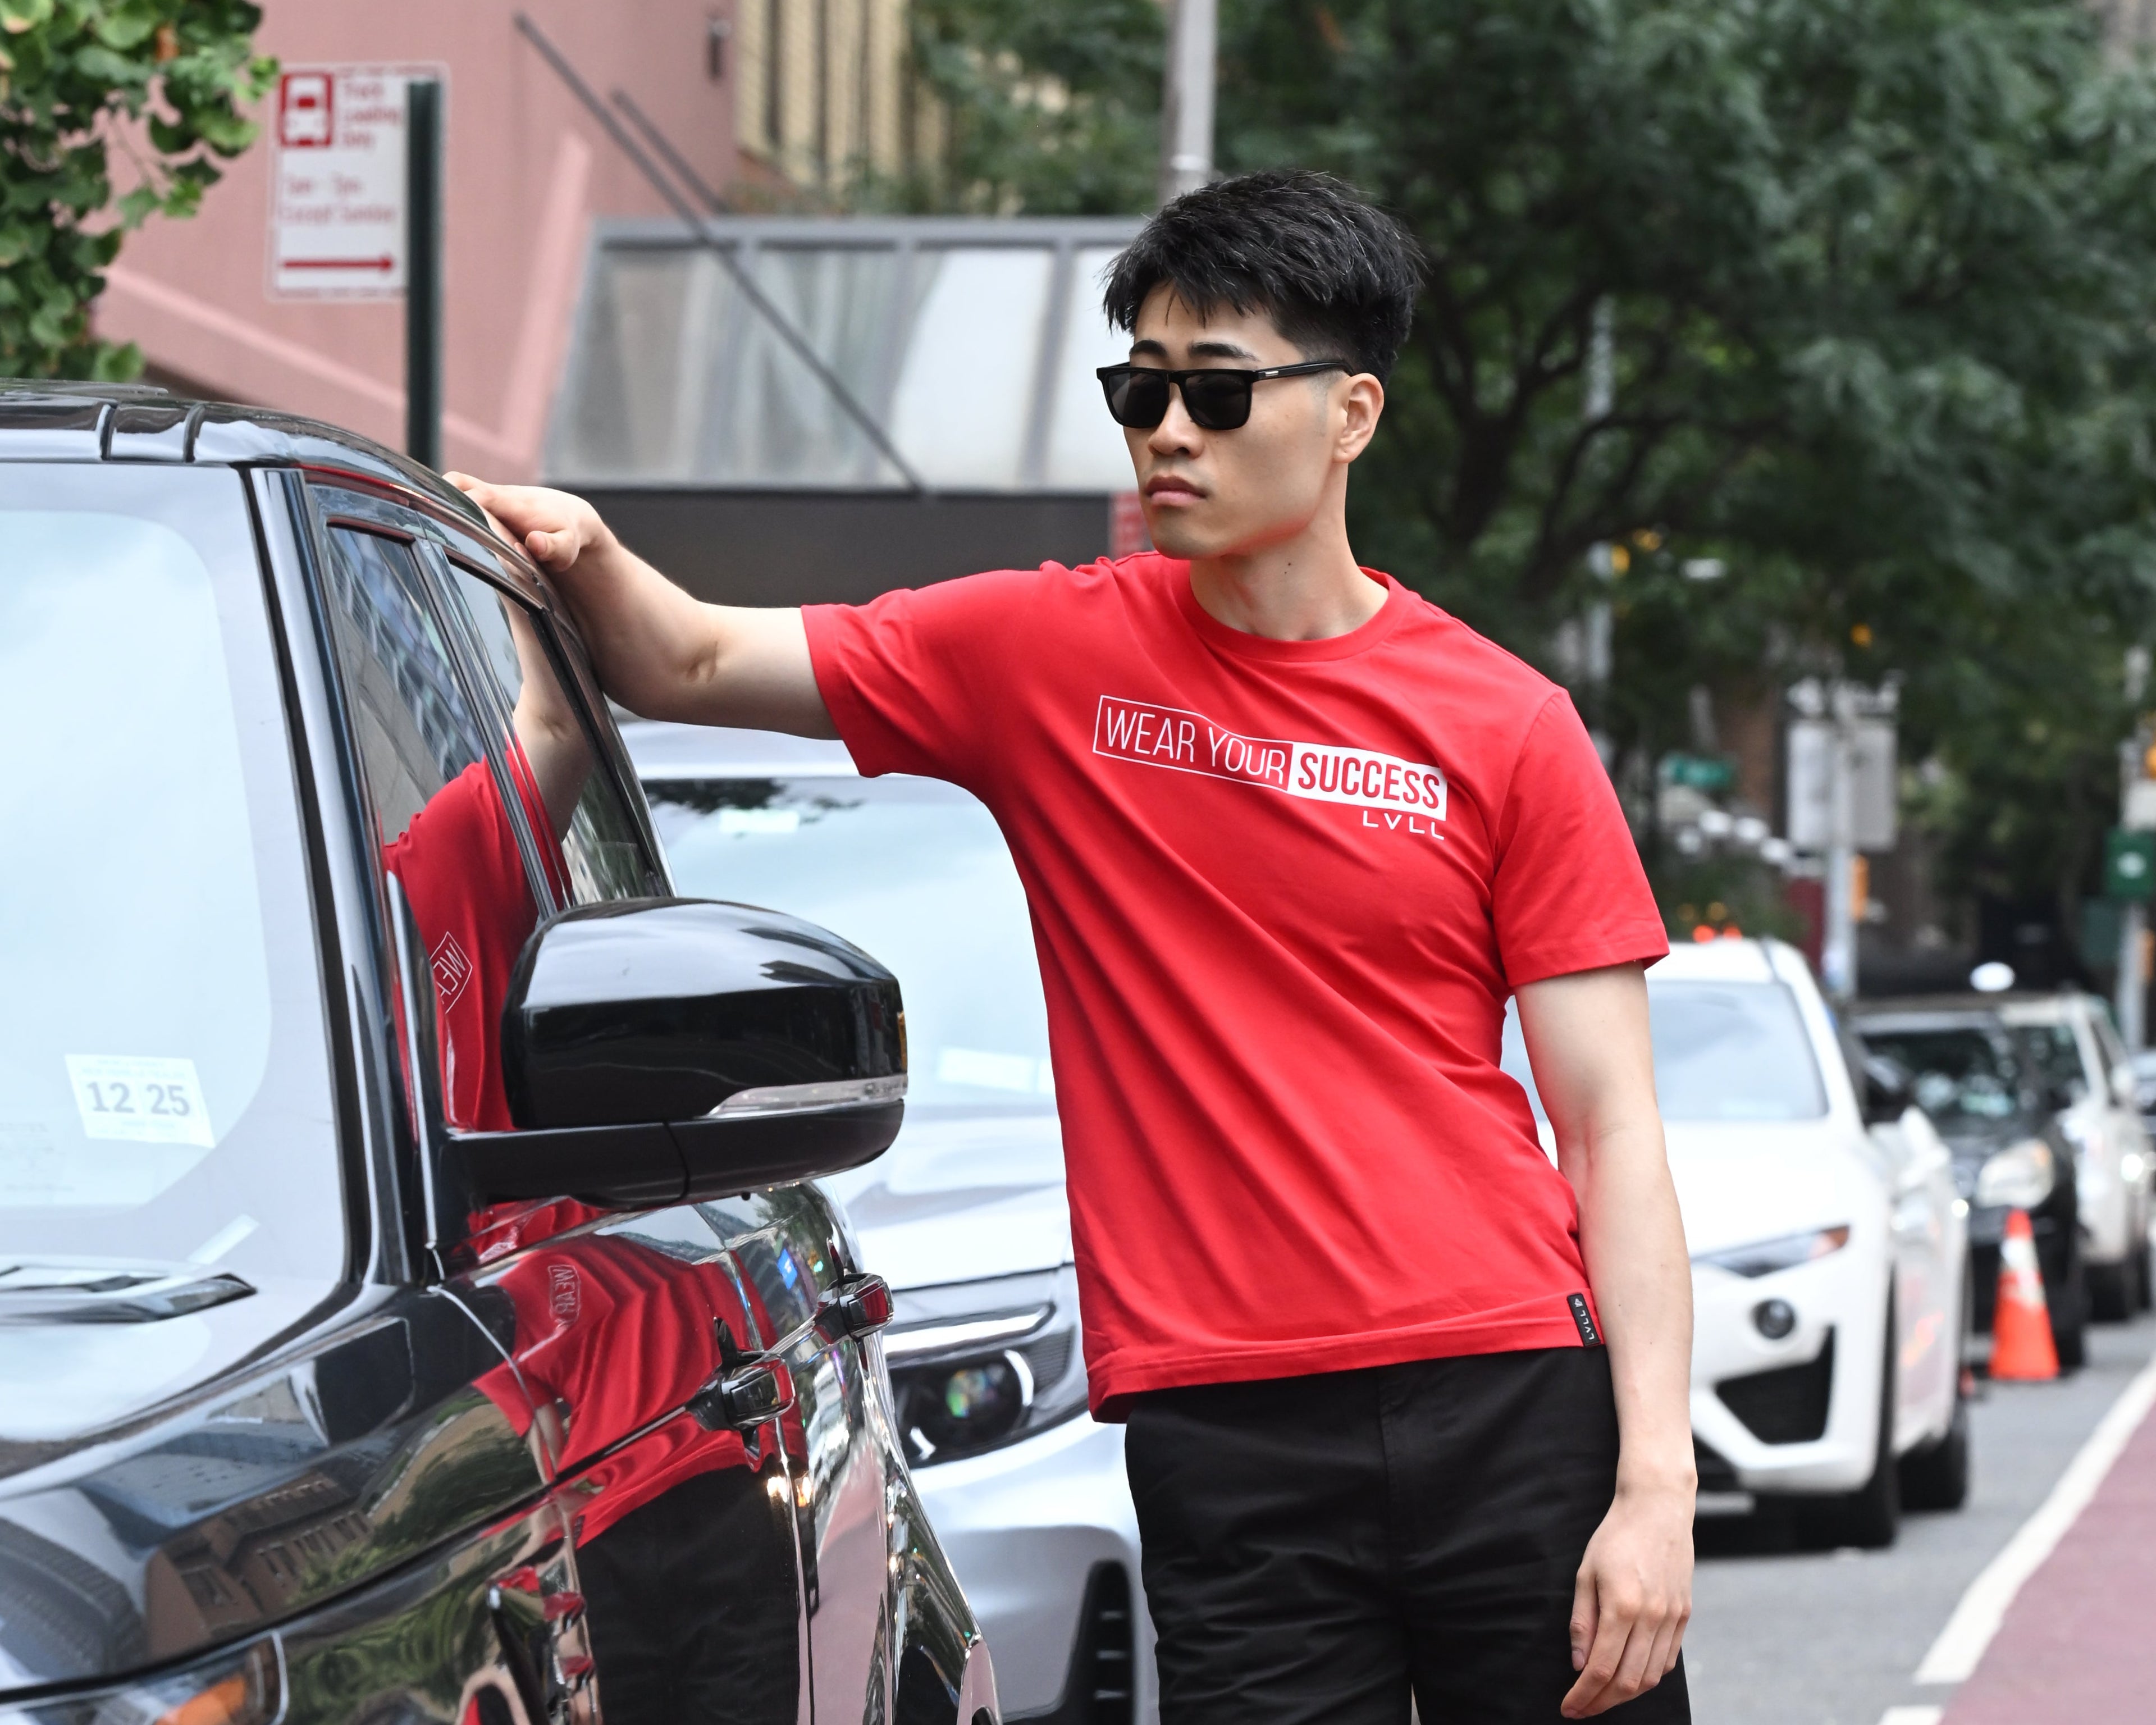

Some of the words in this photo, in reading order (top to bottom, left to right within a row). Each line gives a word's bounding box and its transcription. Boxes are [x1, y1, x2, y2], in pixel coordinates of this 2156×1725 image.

[1107, 706, 1195, 763] WEAR
[1208, 726, 1286, 784] YOUR
[1298, 751, 1440, 809] SUCCESS
[1363, 810, 1445, 840] LVLL
[86, 1081, 136, 1114] 12
[146, 1084, 190, 1117] 25
